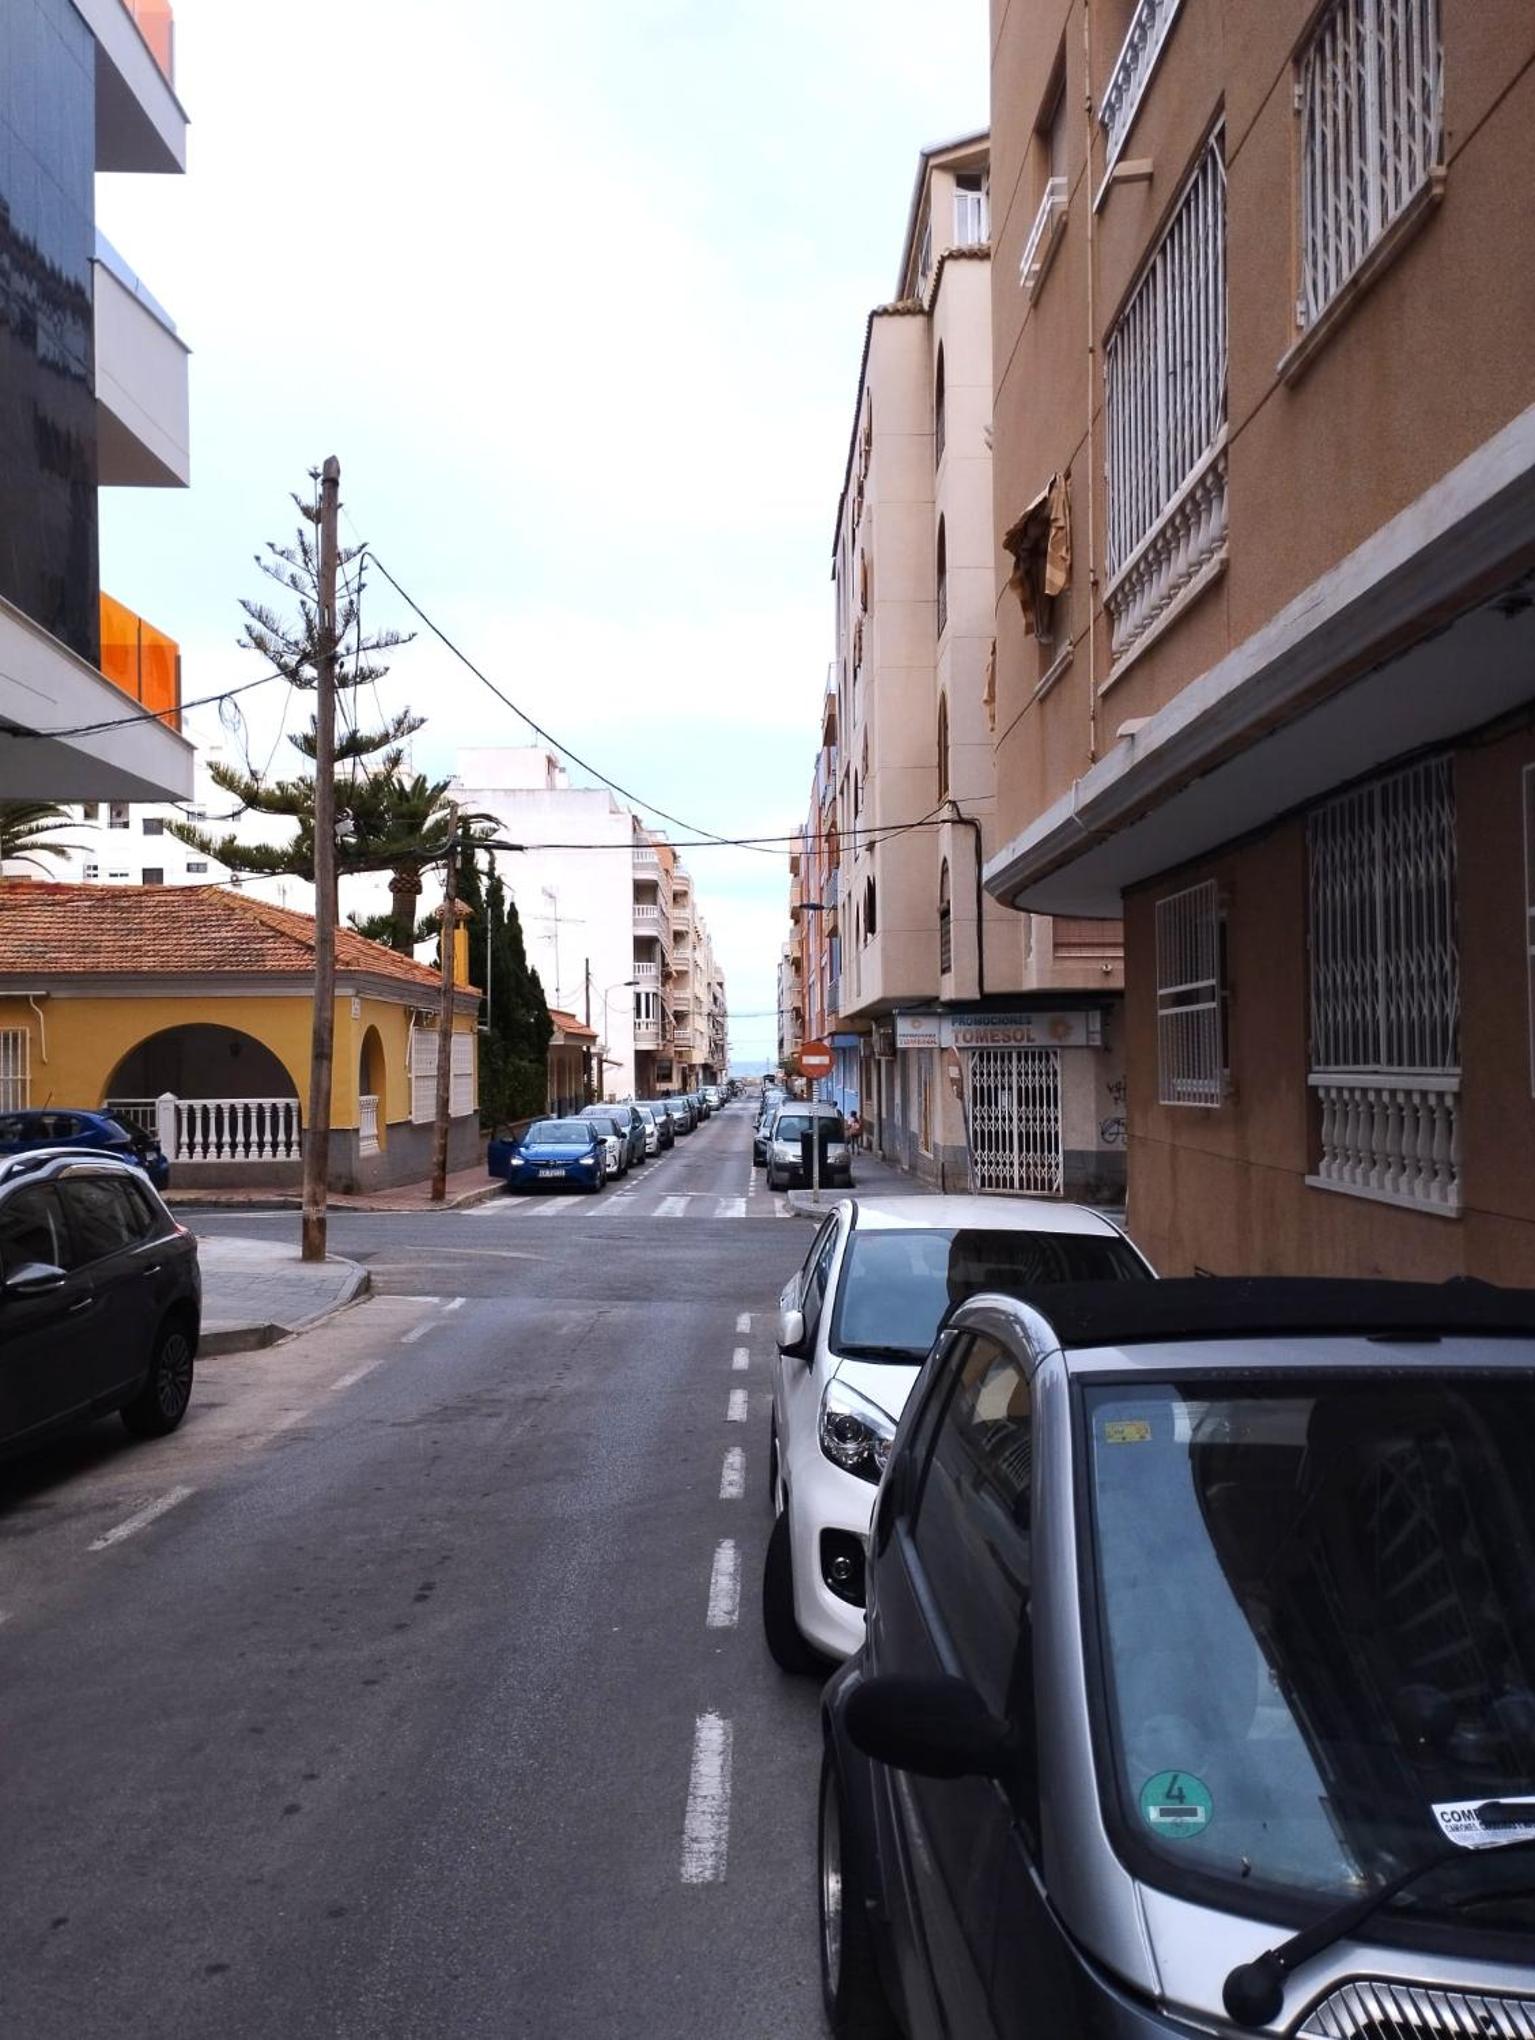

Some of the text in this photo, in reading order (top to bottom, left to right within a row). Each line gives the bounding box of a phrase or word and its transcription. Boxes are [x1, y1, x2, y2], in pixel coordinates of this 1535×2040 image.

[951, 1015, 1032, 1026] PROMOCIONES
[952, 1027, 1036, 1044] TOMESOL
[1166, 1774, 1186, 1804] 4
[1440, 1808, 1481, 1823] COM
